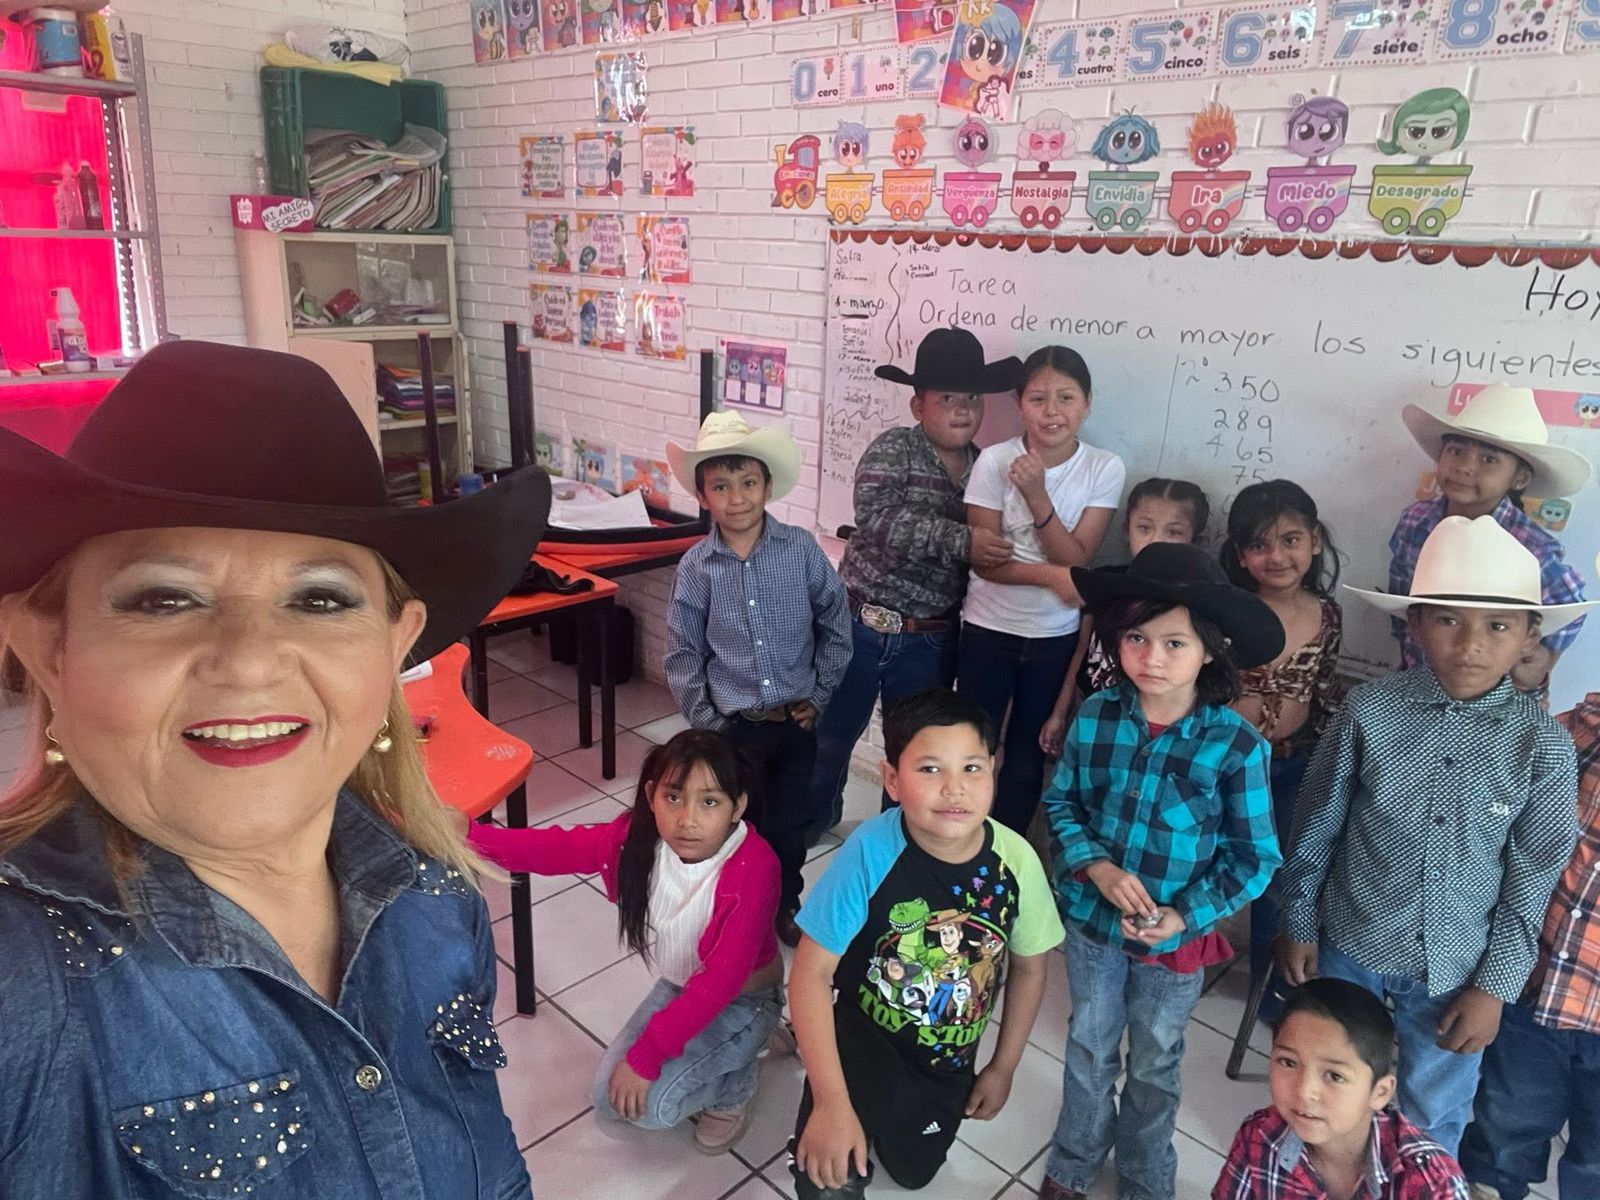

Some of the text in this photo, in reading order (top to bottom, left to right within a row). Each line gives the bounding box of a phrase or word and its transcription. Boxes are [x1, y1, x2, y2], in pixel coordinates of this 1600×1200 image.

[1444, 0, 1500, 49] 8
[1496, 27, 1549, 45] ocho
[1129, 22, 1170, 74] 5
[1222, 11, 1265, 67] 6
[1373, 38, 1419, 55] siete
[1046, 29, 1080, 78] 4
[1164, 56, 1204, 70] cinco
[1267, 45, 1301, 61] seis
[850, 54, 868, 97] 1
[908, 46, 938, 92] 2
[1077, 64, 1114, 75] cuatro
[793, 61, 817, 102] 0
[817, 88, 839, 98] cero
[875, 82, 895, 92] uno
[888, 182, 929, 194] Ansiedad
[1014, 185, 1069, 201] Nostalgia
[1094, 185, 1146, 203] Envidia
[1191, 185, 1224, 206] Ira
[1278, 183, 1338, 201] Miedo
[1375, 183, 1461, 200] Desagrado
[262, 210, 277, 223] MI
[278, 199, 309, 218] AMIGO
[270, 208, 311, 232] SECRETO
[948, 268, 1017, 296] Tarea
[919, 299, 1600, 388] Ordena de menor a mayor los siguientes
[1214, 371, 1280, 403] 350
[1213, 408, 1273, 443] 289
[1205, 433, 1274, 464] 465
[858, 983, 923, 1034] TOY
